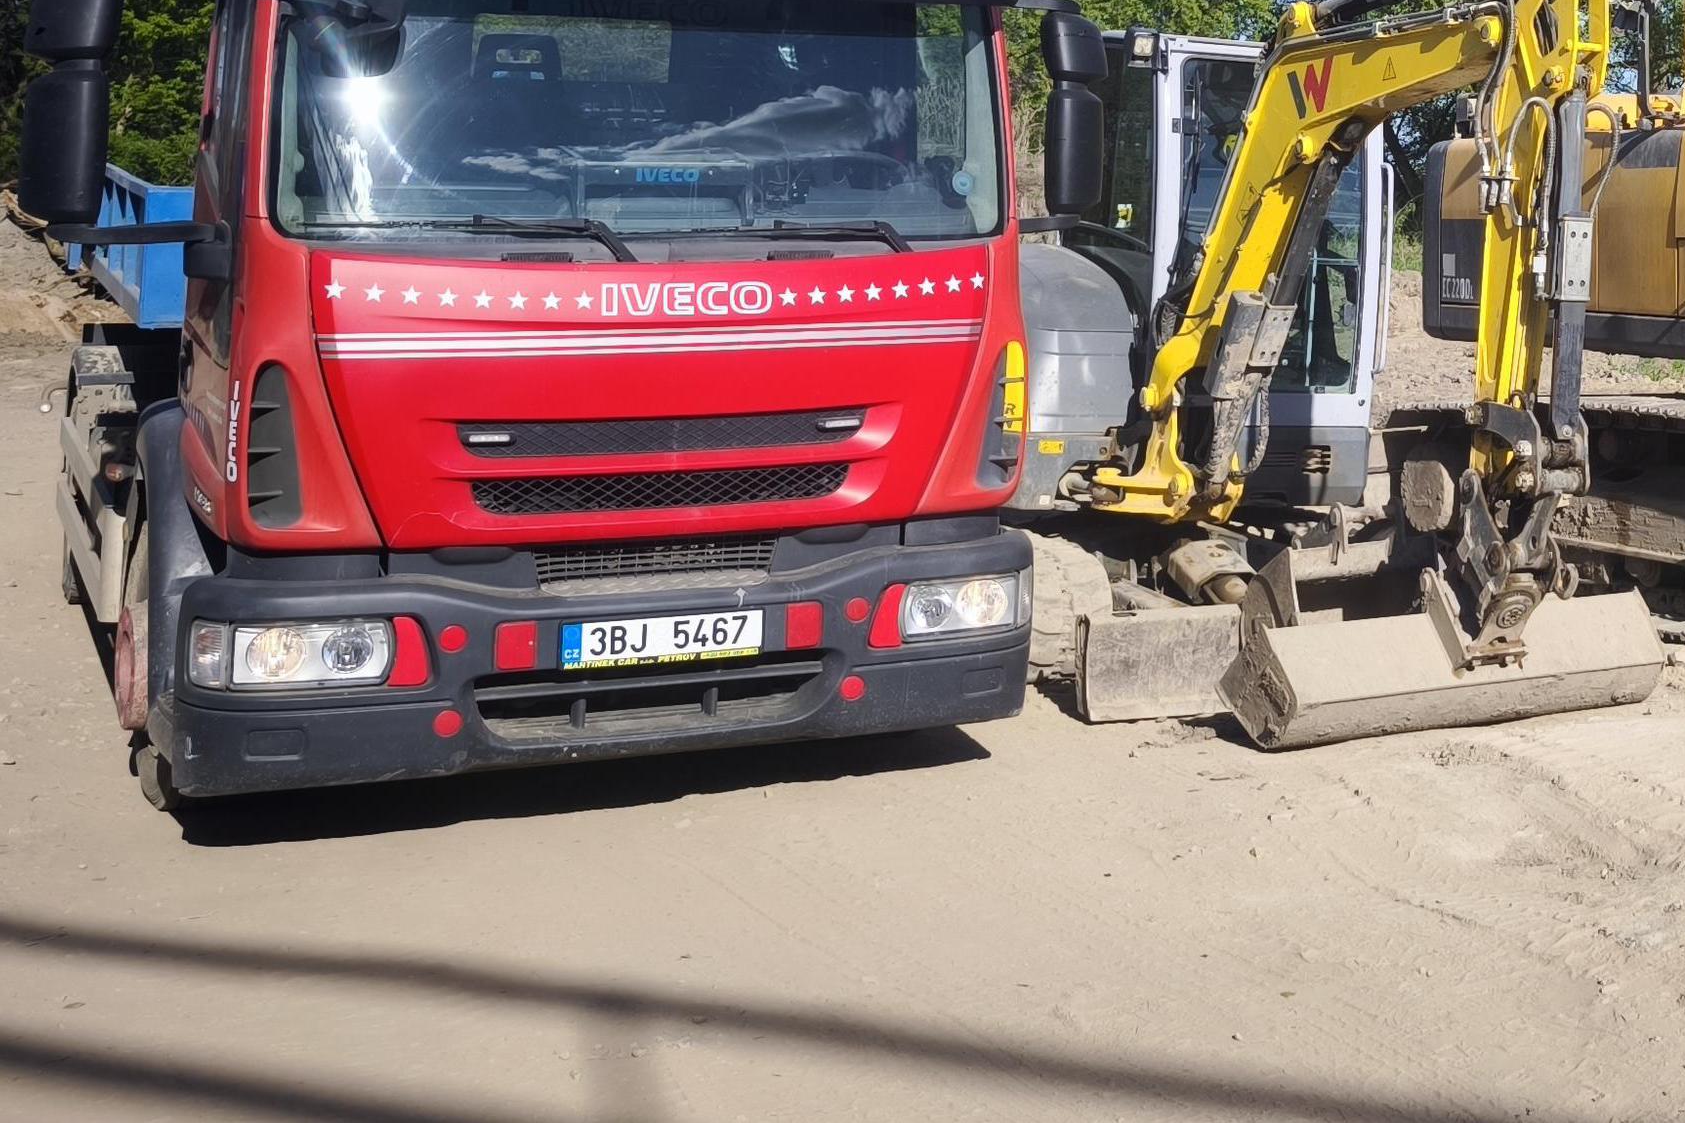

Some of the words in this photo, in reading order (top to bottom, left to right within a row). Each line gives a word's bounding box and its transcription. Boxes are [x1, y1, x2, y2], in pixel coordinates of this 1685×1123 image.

[635, 167, 700, 182] IVECO
[601, 281, 773, 316] IVECO
[226, 380, 240, 483] IVECO
[589, 623, 648, 656] 3BJ
[673, 615, 748, 649] 5467
[564, 648, 580, 659] CZ
[618, 657, 638, 666] CAR
